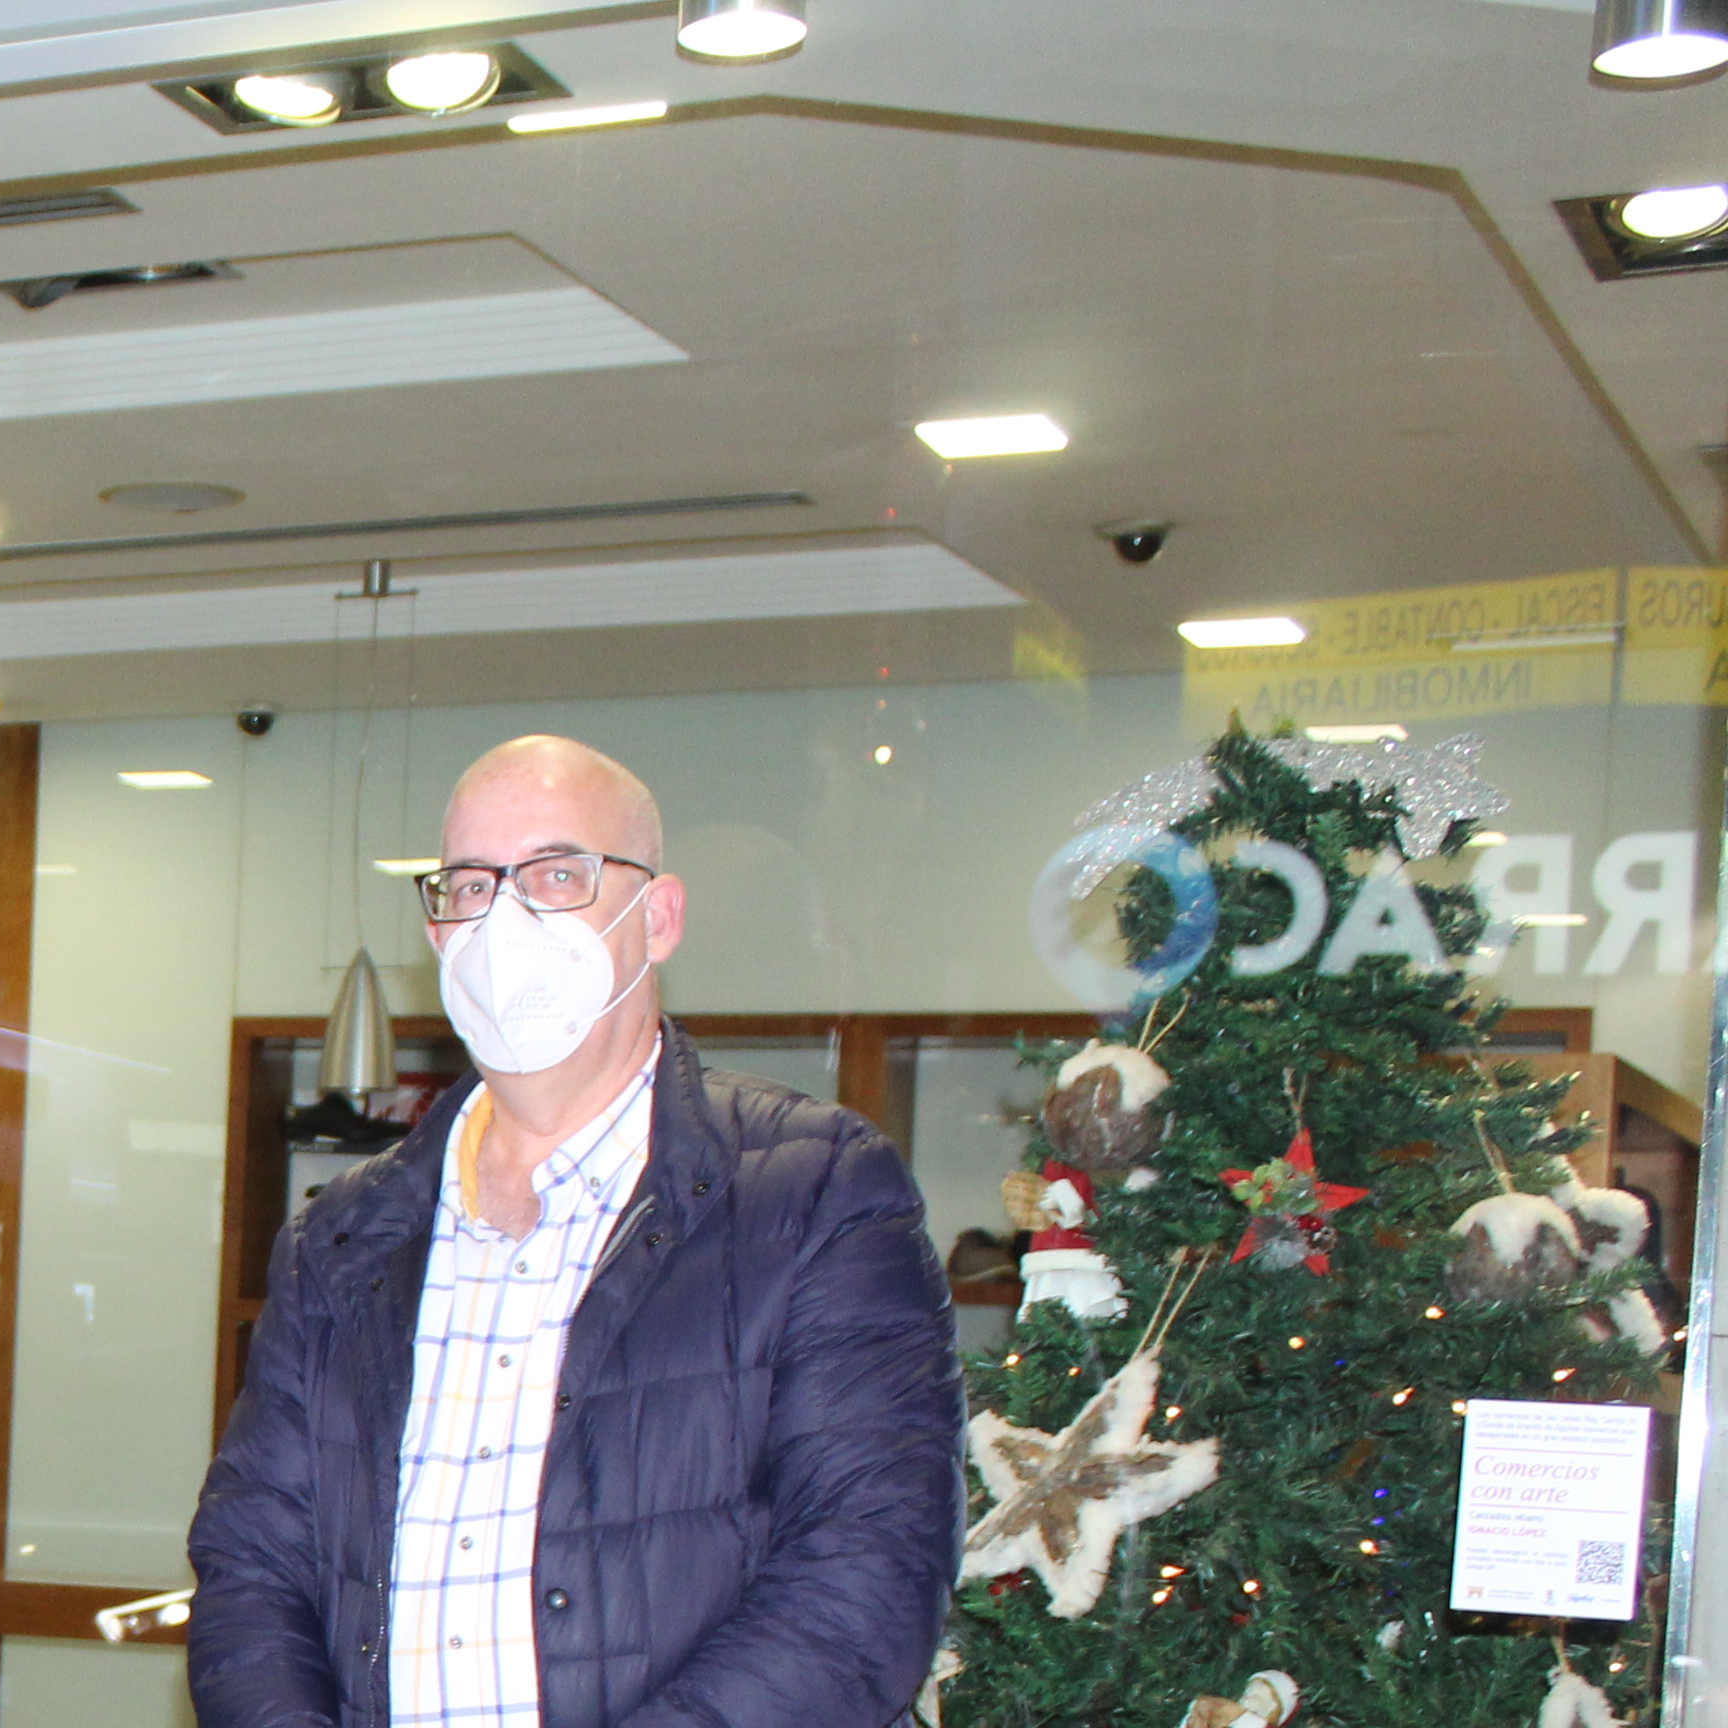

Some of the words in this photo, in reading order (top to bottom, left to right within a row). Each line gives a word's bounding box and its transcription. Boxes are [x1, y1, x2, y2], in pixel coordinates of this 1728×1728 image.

[1474, 1455, 1599, 1481] Comercios
[1470, 1485, 1512, 1500] con
[1520, 1485, 1570, 1504] arte
